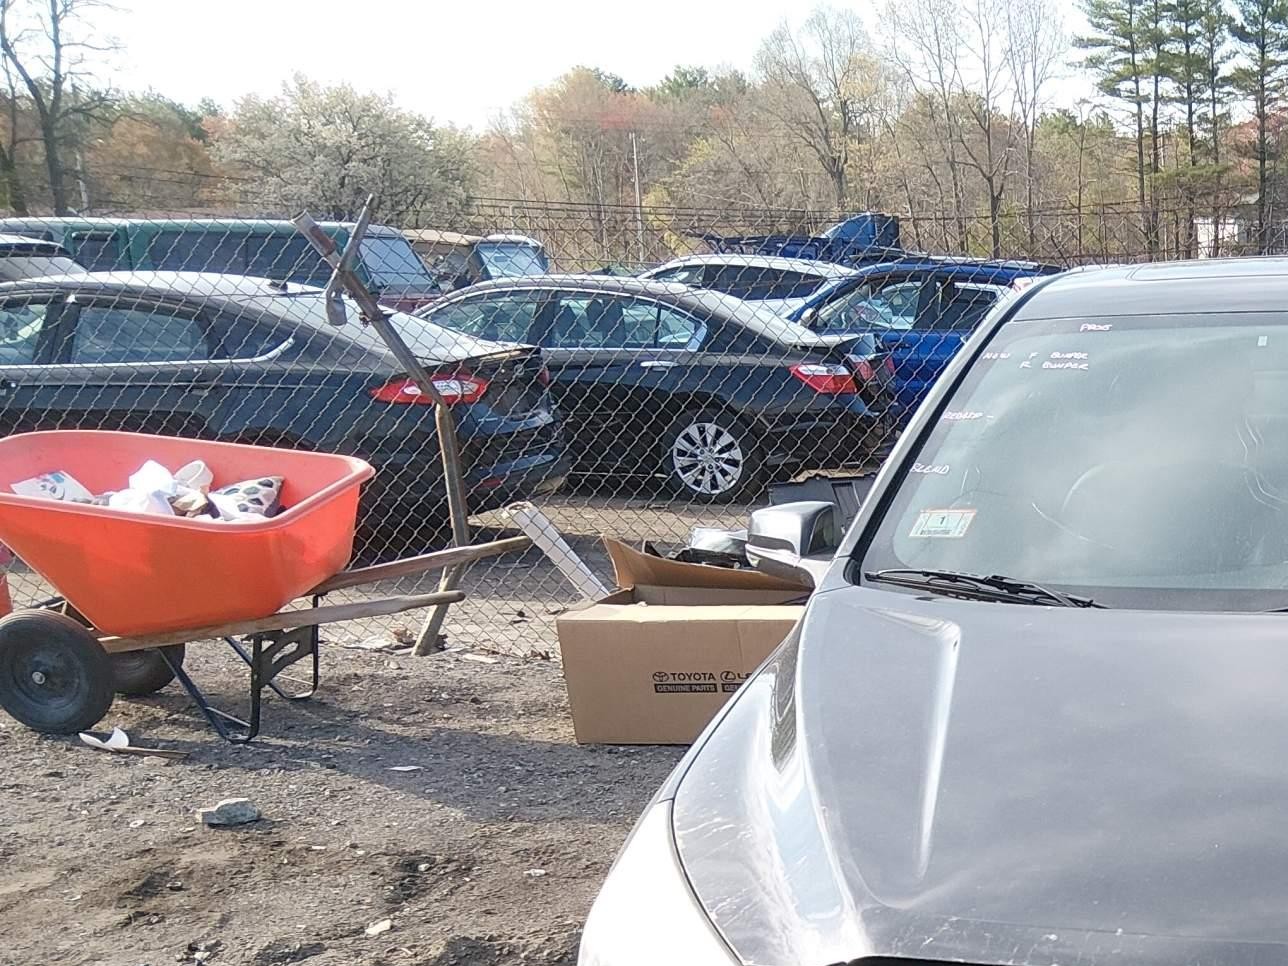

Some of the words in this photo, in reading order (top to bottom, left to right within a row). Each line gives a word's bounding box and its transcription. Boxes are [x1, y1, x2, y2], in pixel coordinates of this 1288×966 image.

[670, 672, 716, 681] TOYOTA
[657, 684, 691, 692] GENUINE
[692, 684, 715, 692] PARTS
